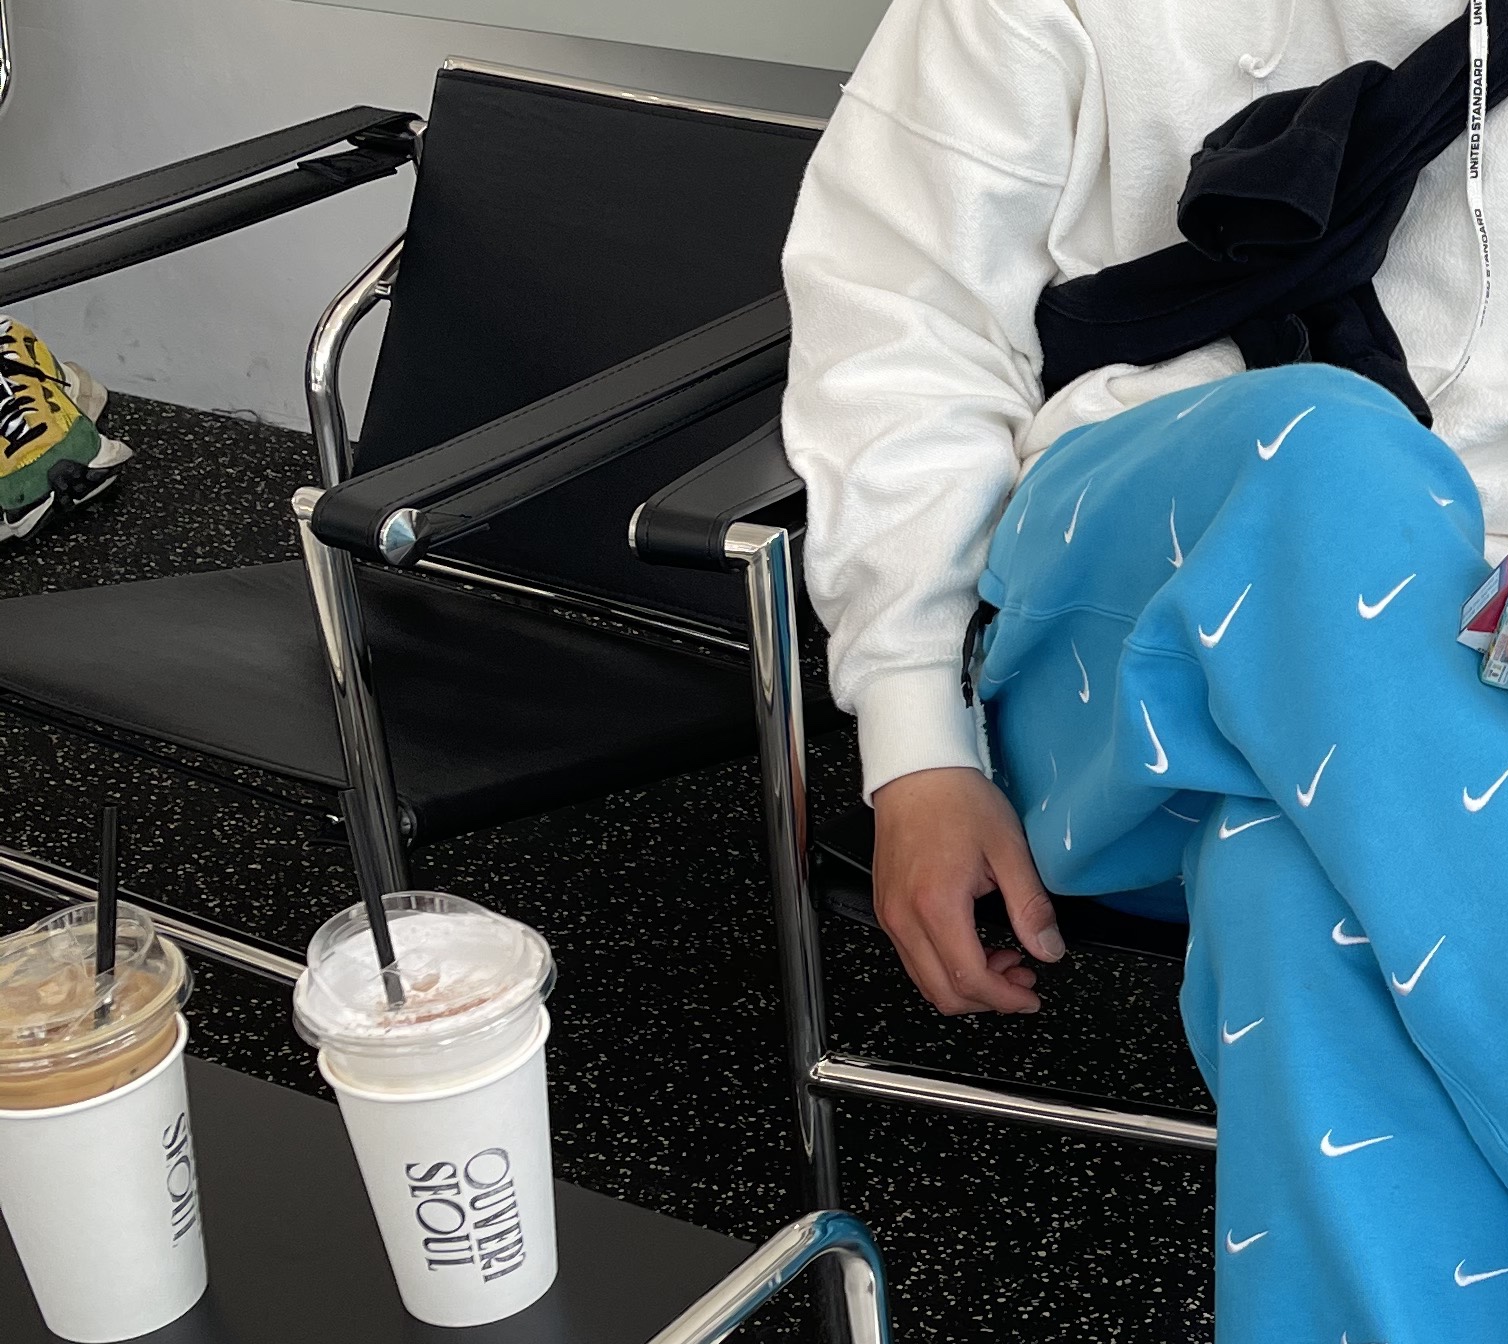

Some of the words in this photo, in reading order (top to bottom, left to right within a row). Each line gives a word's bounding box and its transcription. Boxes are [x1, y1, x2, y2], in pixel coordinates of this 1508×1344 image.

[1471, 58, 1483, 131] STANDARD
[1470, 133, 1480, 179] UNITED
[404, 1161, 475, 1272] SEOUL
